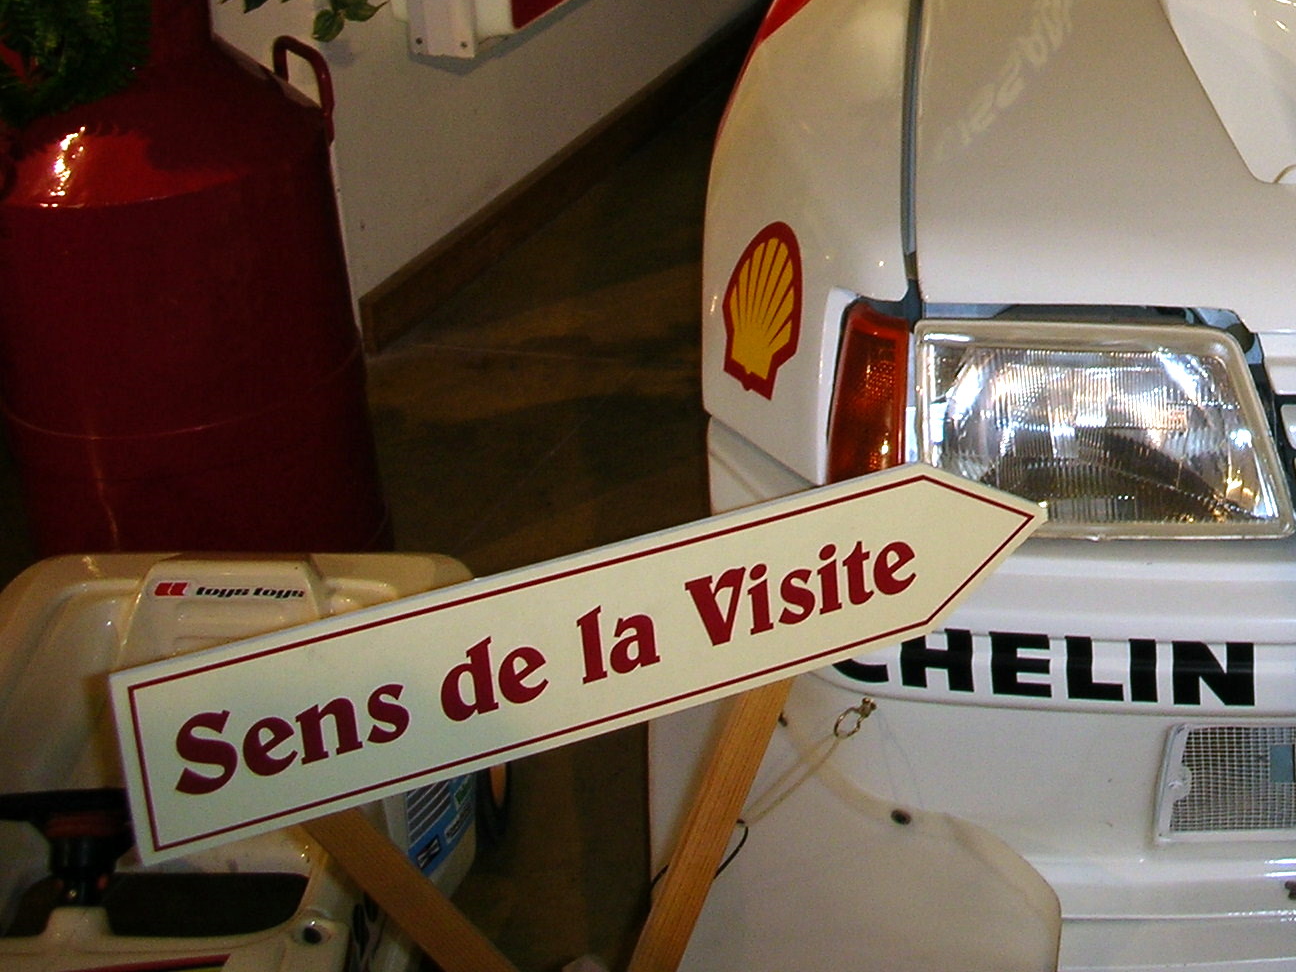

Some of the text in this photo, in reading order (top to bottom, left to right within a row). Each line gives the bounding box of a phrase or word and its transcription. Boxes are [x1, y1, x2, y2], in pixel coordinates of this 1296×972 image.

[196, 586, 305, 599] toys toys
[174, 540, 917, 796] Sens de la Visite
